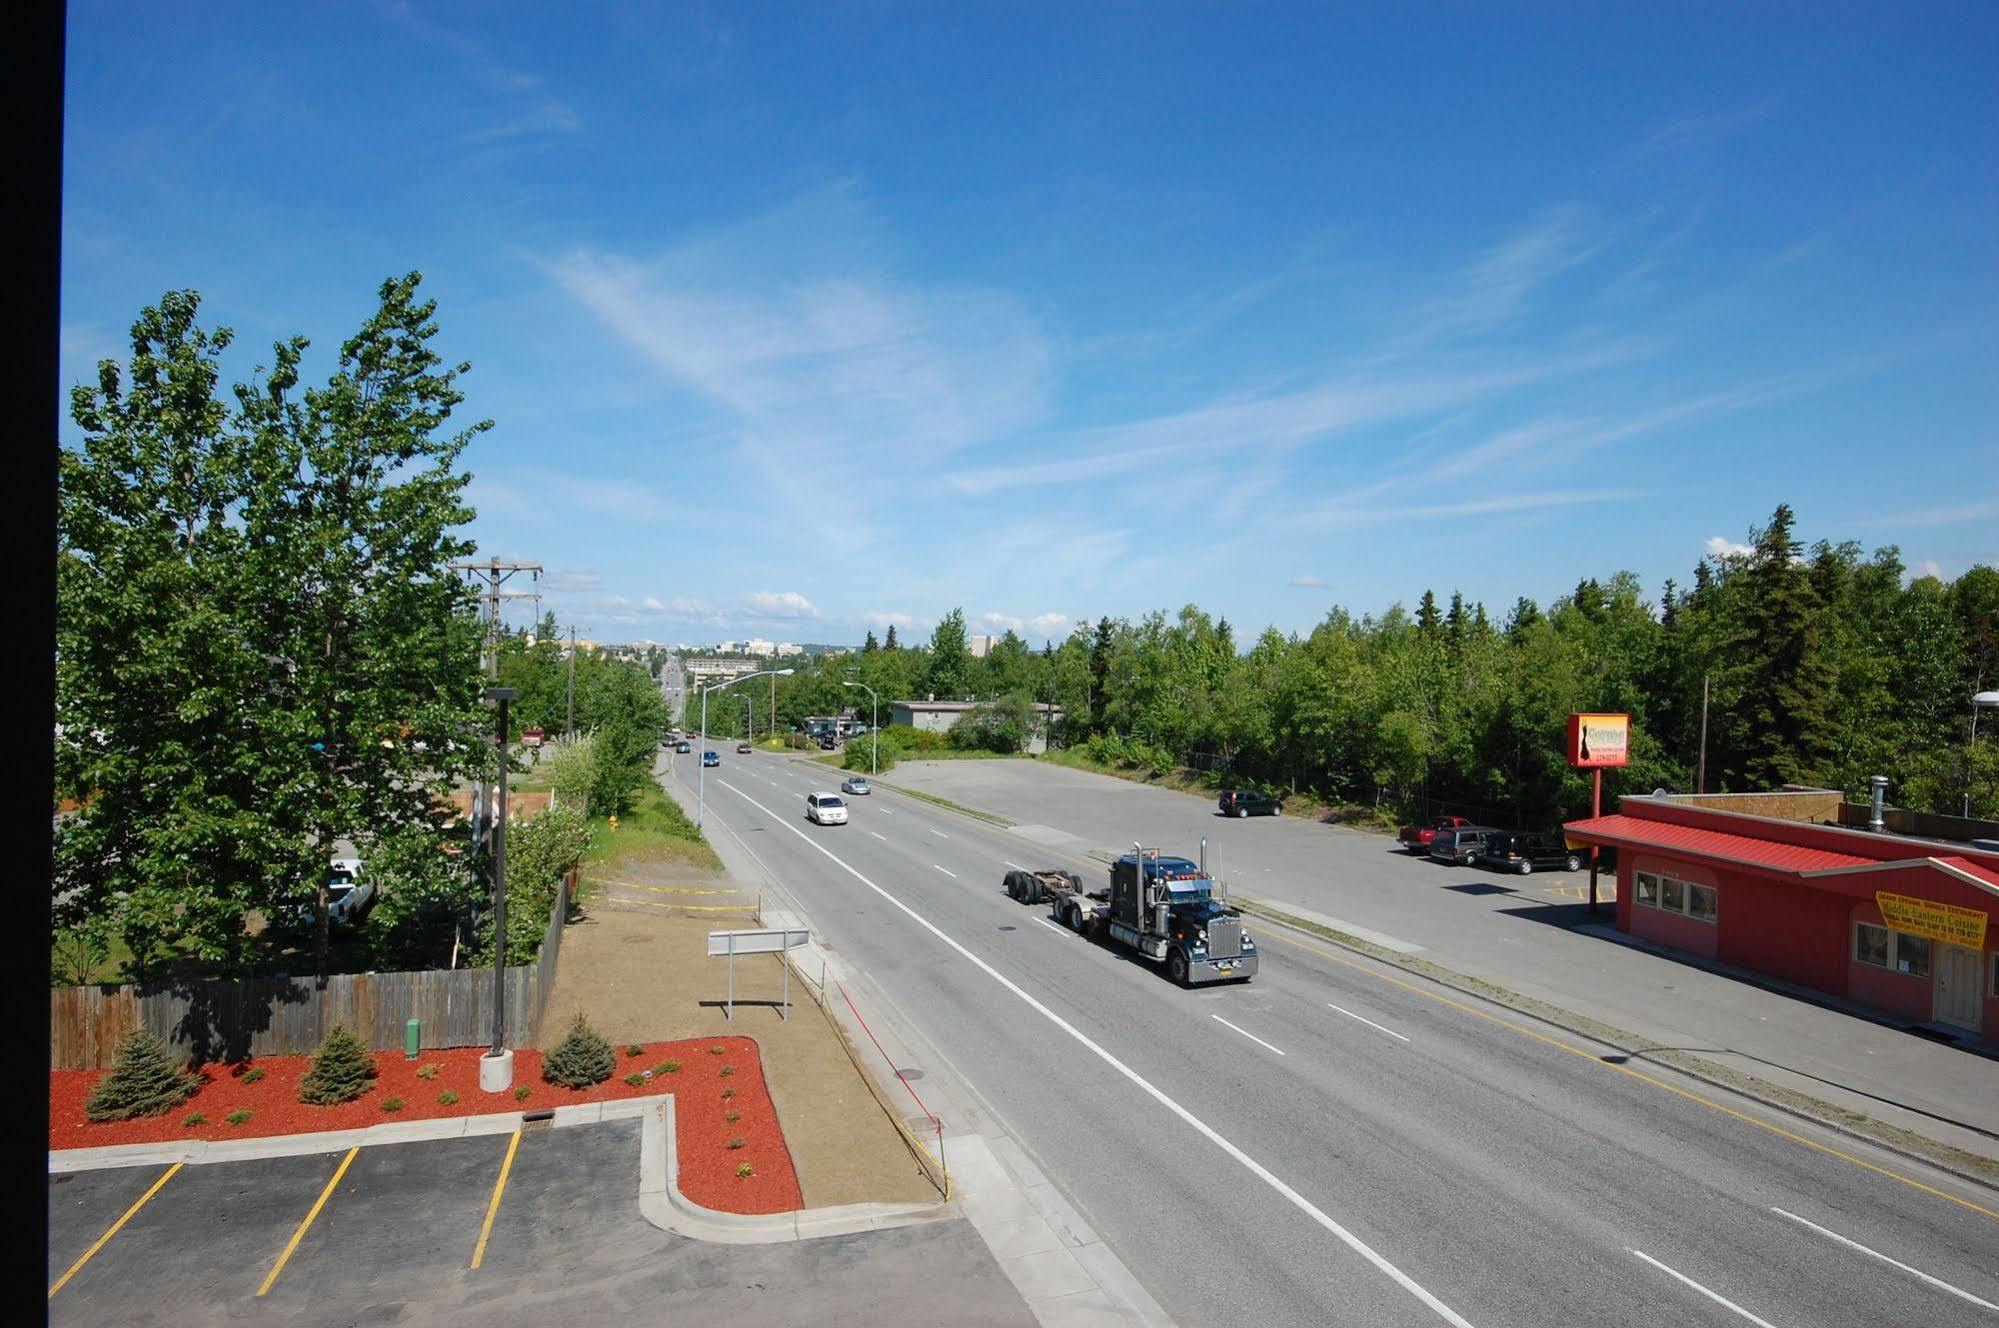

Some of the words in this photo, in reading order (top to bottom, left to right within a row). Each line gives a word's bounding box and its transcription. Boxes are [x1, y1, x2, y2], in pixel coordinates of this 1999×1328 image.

[1881, 900, 1910, 917] Middle
[1912, 906, 1944, 924] Eastern
[1948, 914, 1980, 931] Cuisine
